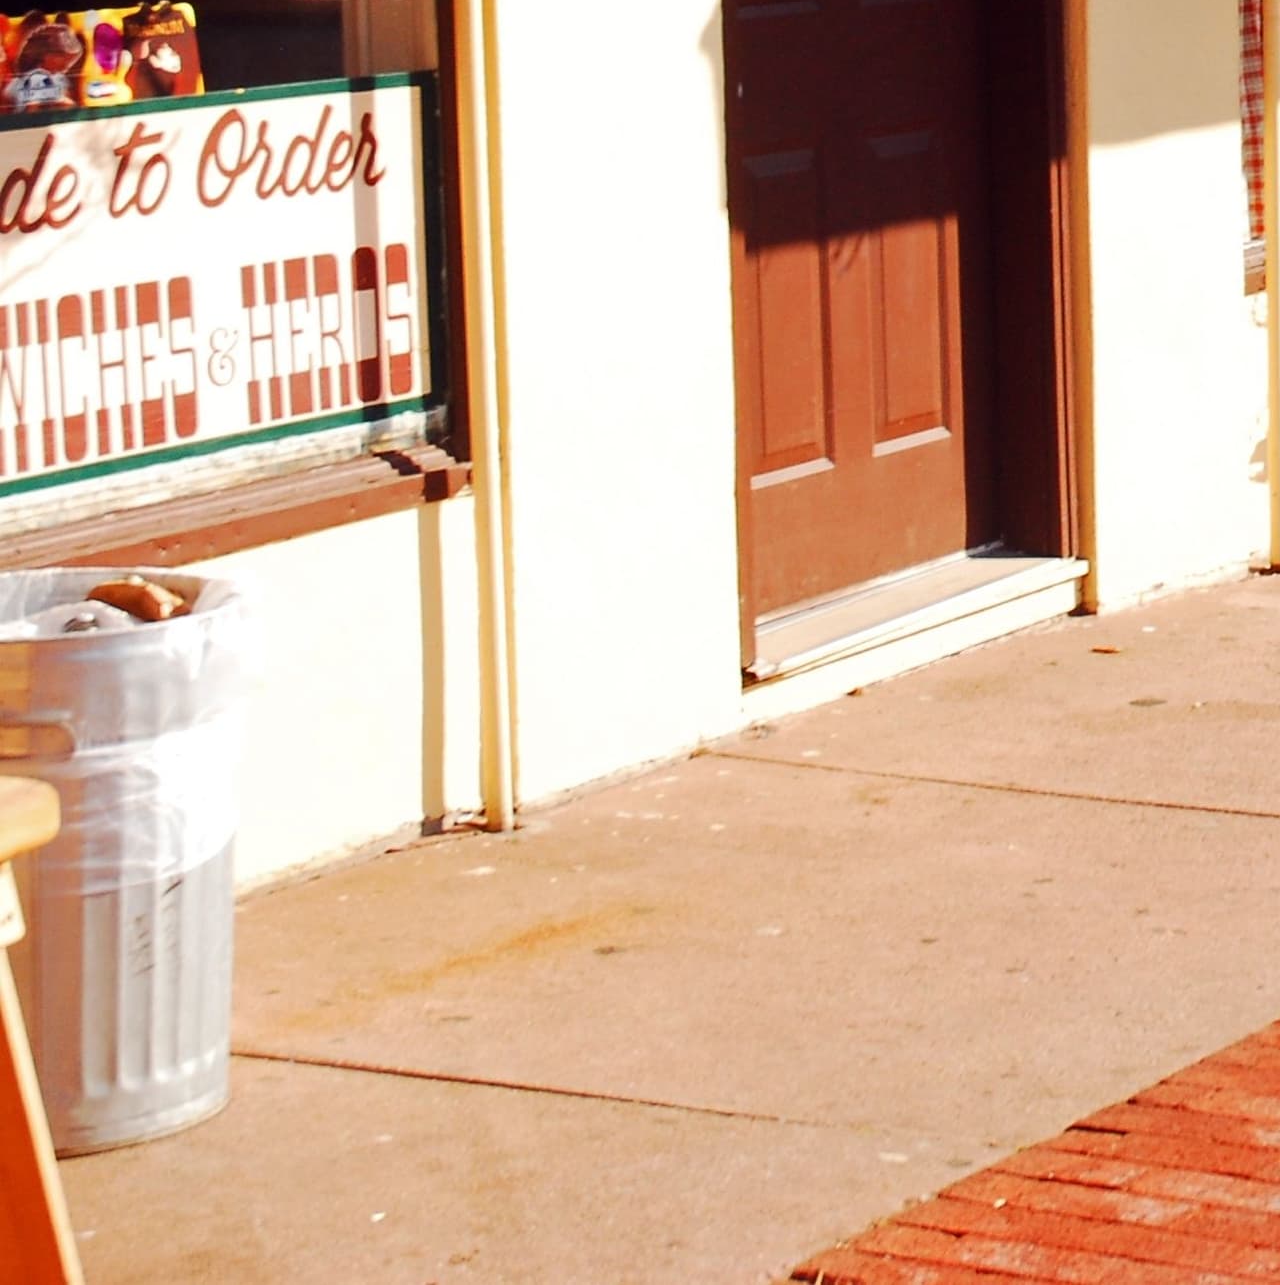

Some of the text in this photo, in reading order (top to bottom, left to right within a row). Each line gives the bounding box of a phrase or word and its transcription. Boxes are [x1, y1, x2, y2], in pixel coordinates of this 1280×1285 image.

[109, 121, 172, 219] to
[196, 104, 388, 209] Order
[207, 326, 241, 387] &
[240, 242, 415, 427] HEROS
